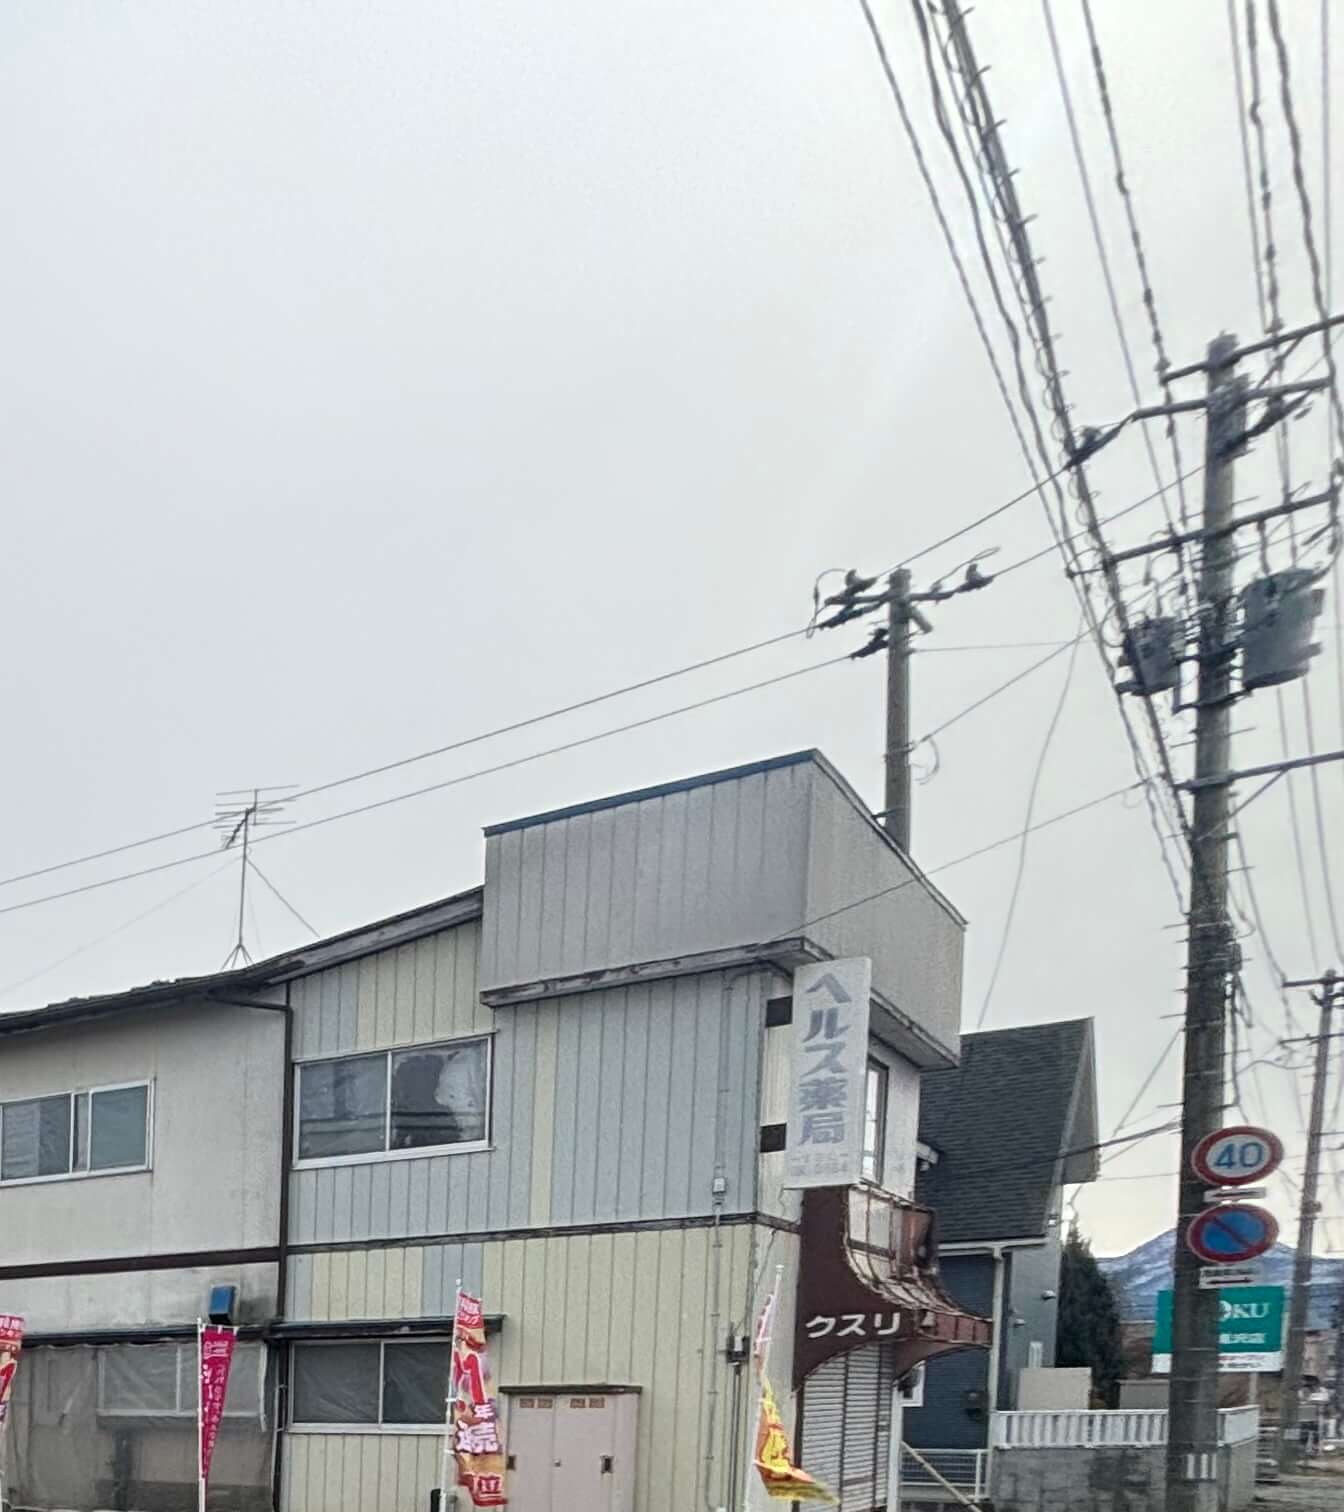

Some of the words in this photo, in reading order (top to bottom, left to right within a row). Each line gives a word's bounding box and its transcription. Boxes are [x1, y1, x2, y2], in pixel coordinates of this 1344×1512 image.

[798, 973, 852, 1146] ヘルス薬局
[1214, 1142, 1262, 1169] 40
[805, 1311, 901, 1338] クスリ
